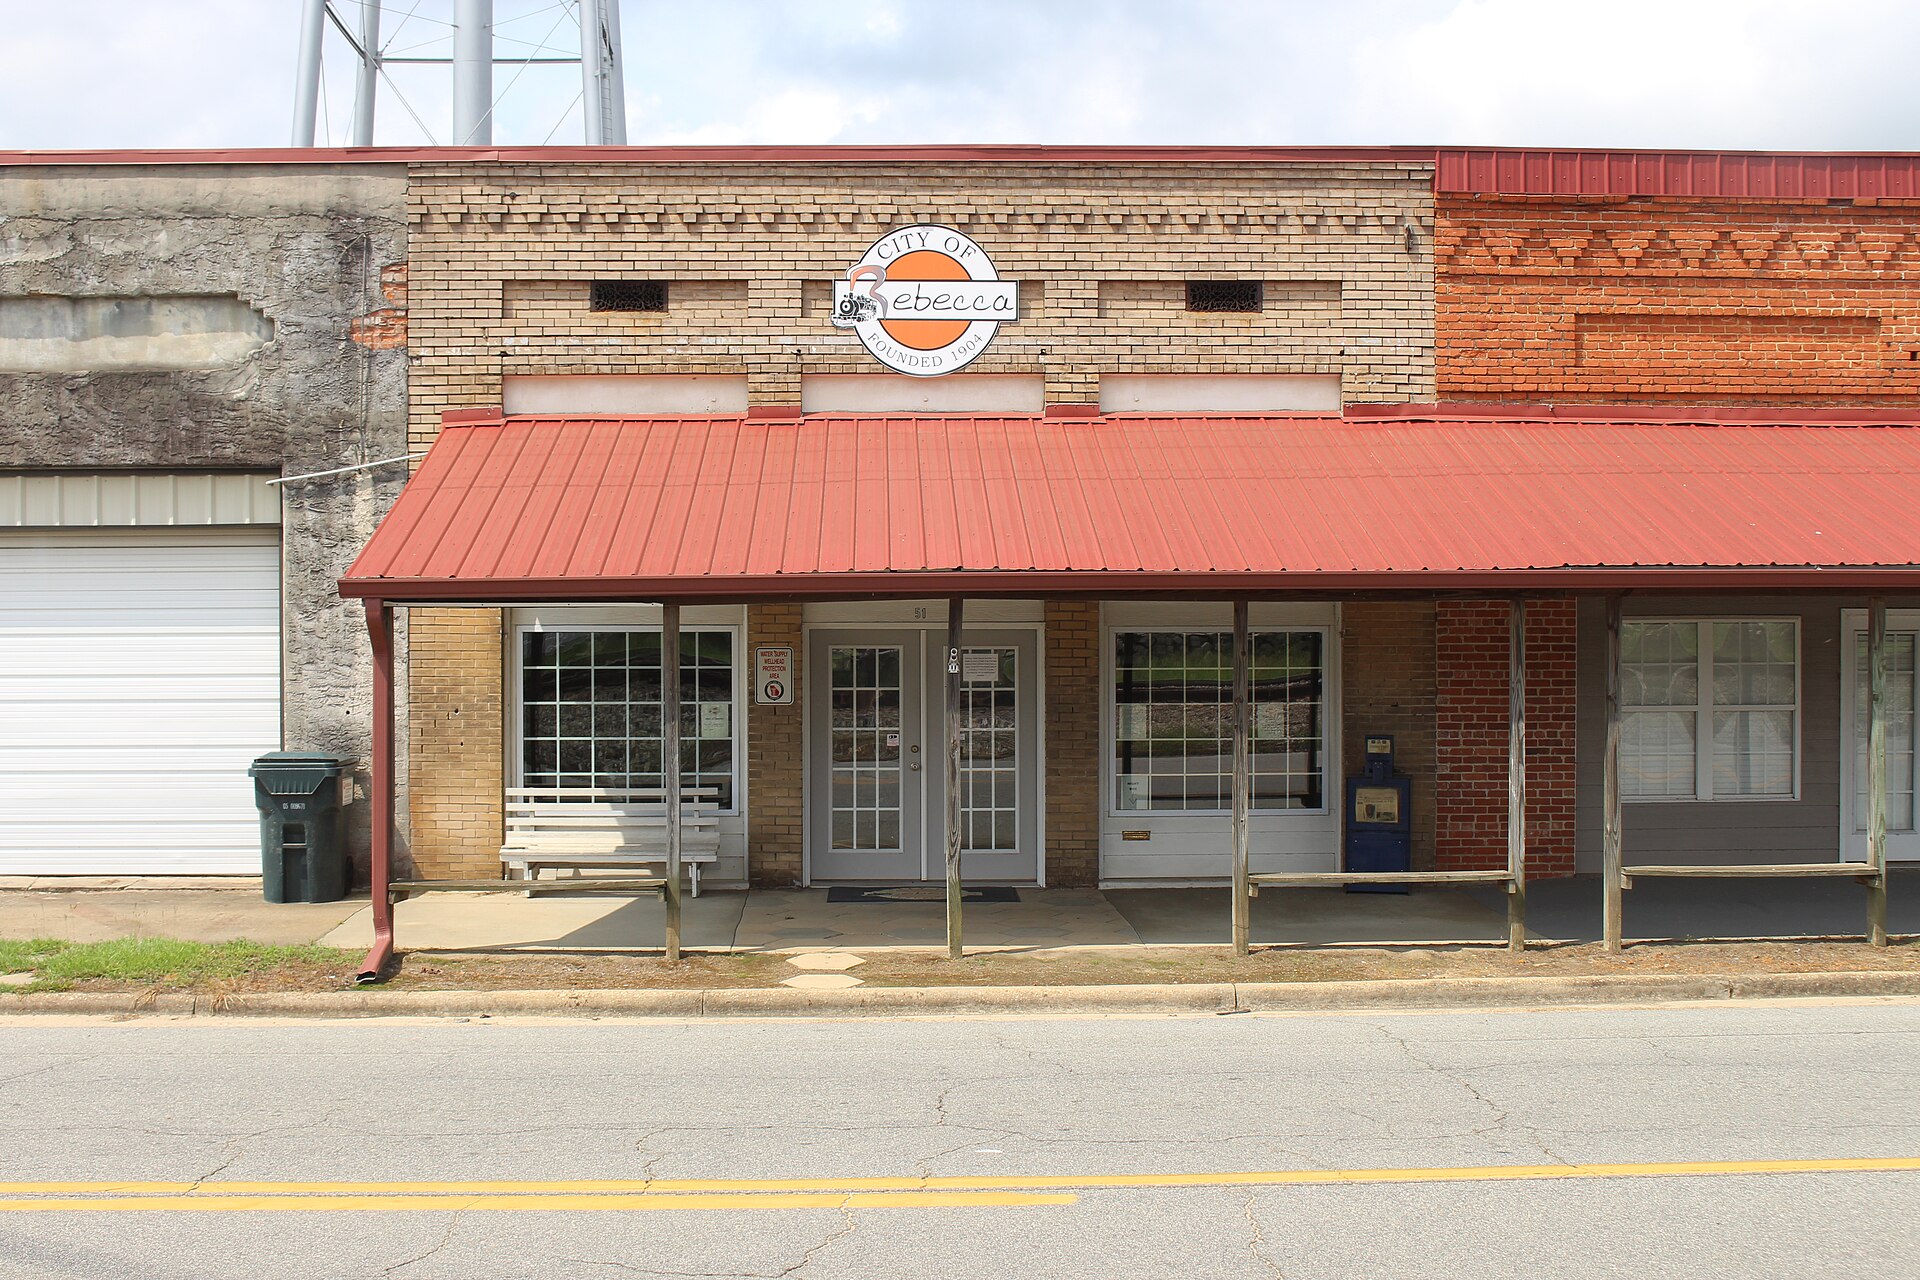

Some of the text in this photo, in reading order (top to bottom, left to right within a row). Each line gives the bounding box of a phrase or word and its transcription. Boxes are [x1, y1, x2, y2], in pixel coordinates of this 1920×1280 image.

[877, 231, 977, 260] CITY OF
[850, 264, 1015, 320] Rebecca
[867, 332, 983, 368] FOUNDED 1904
[914, 607, 927, 619] 51
